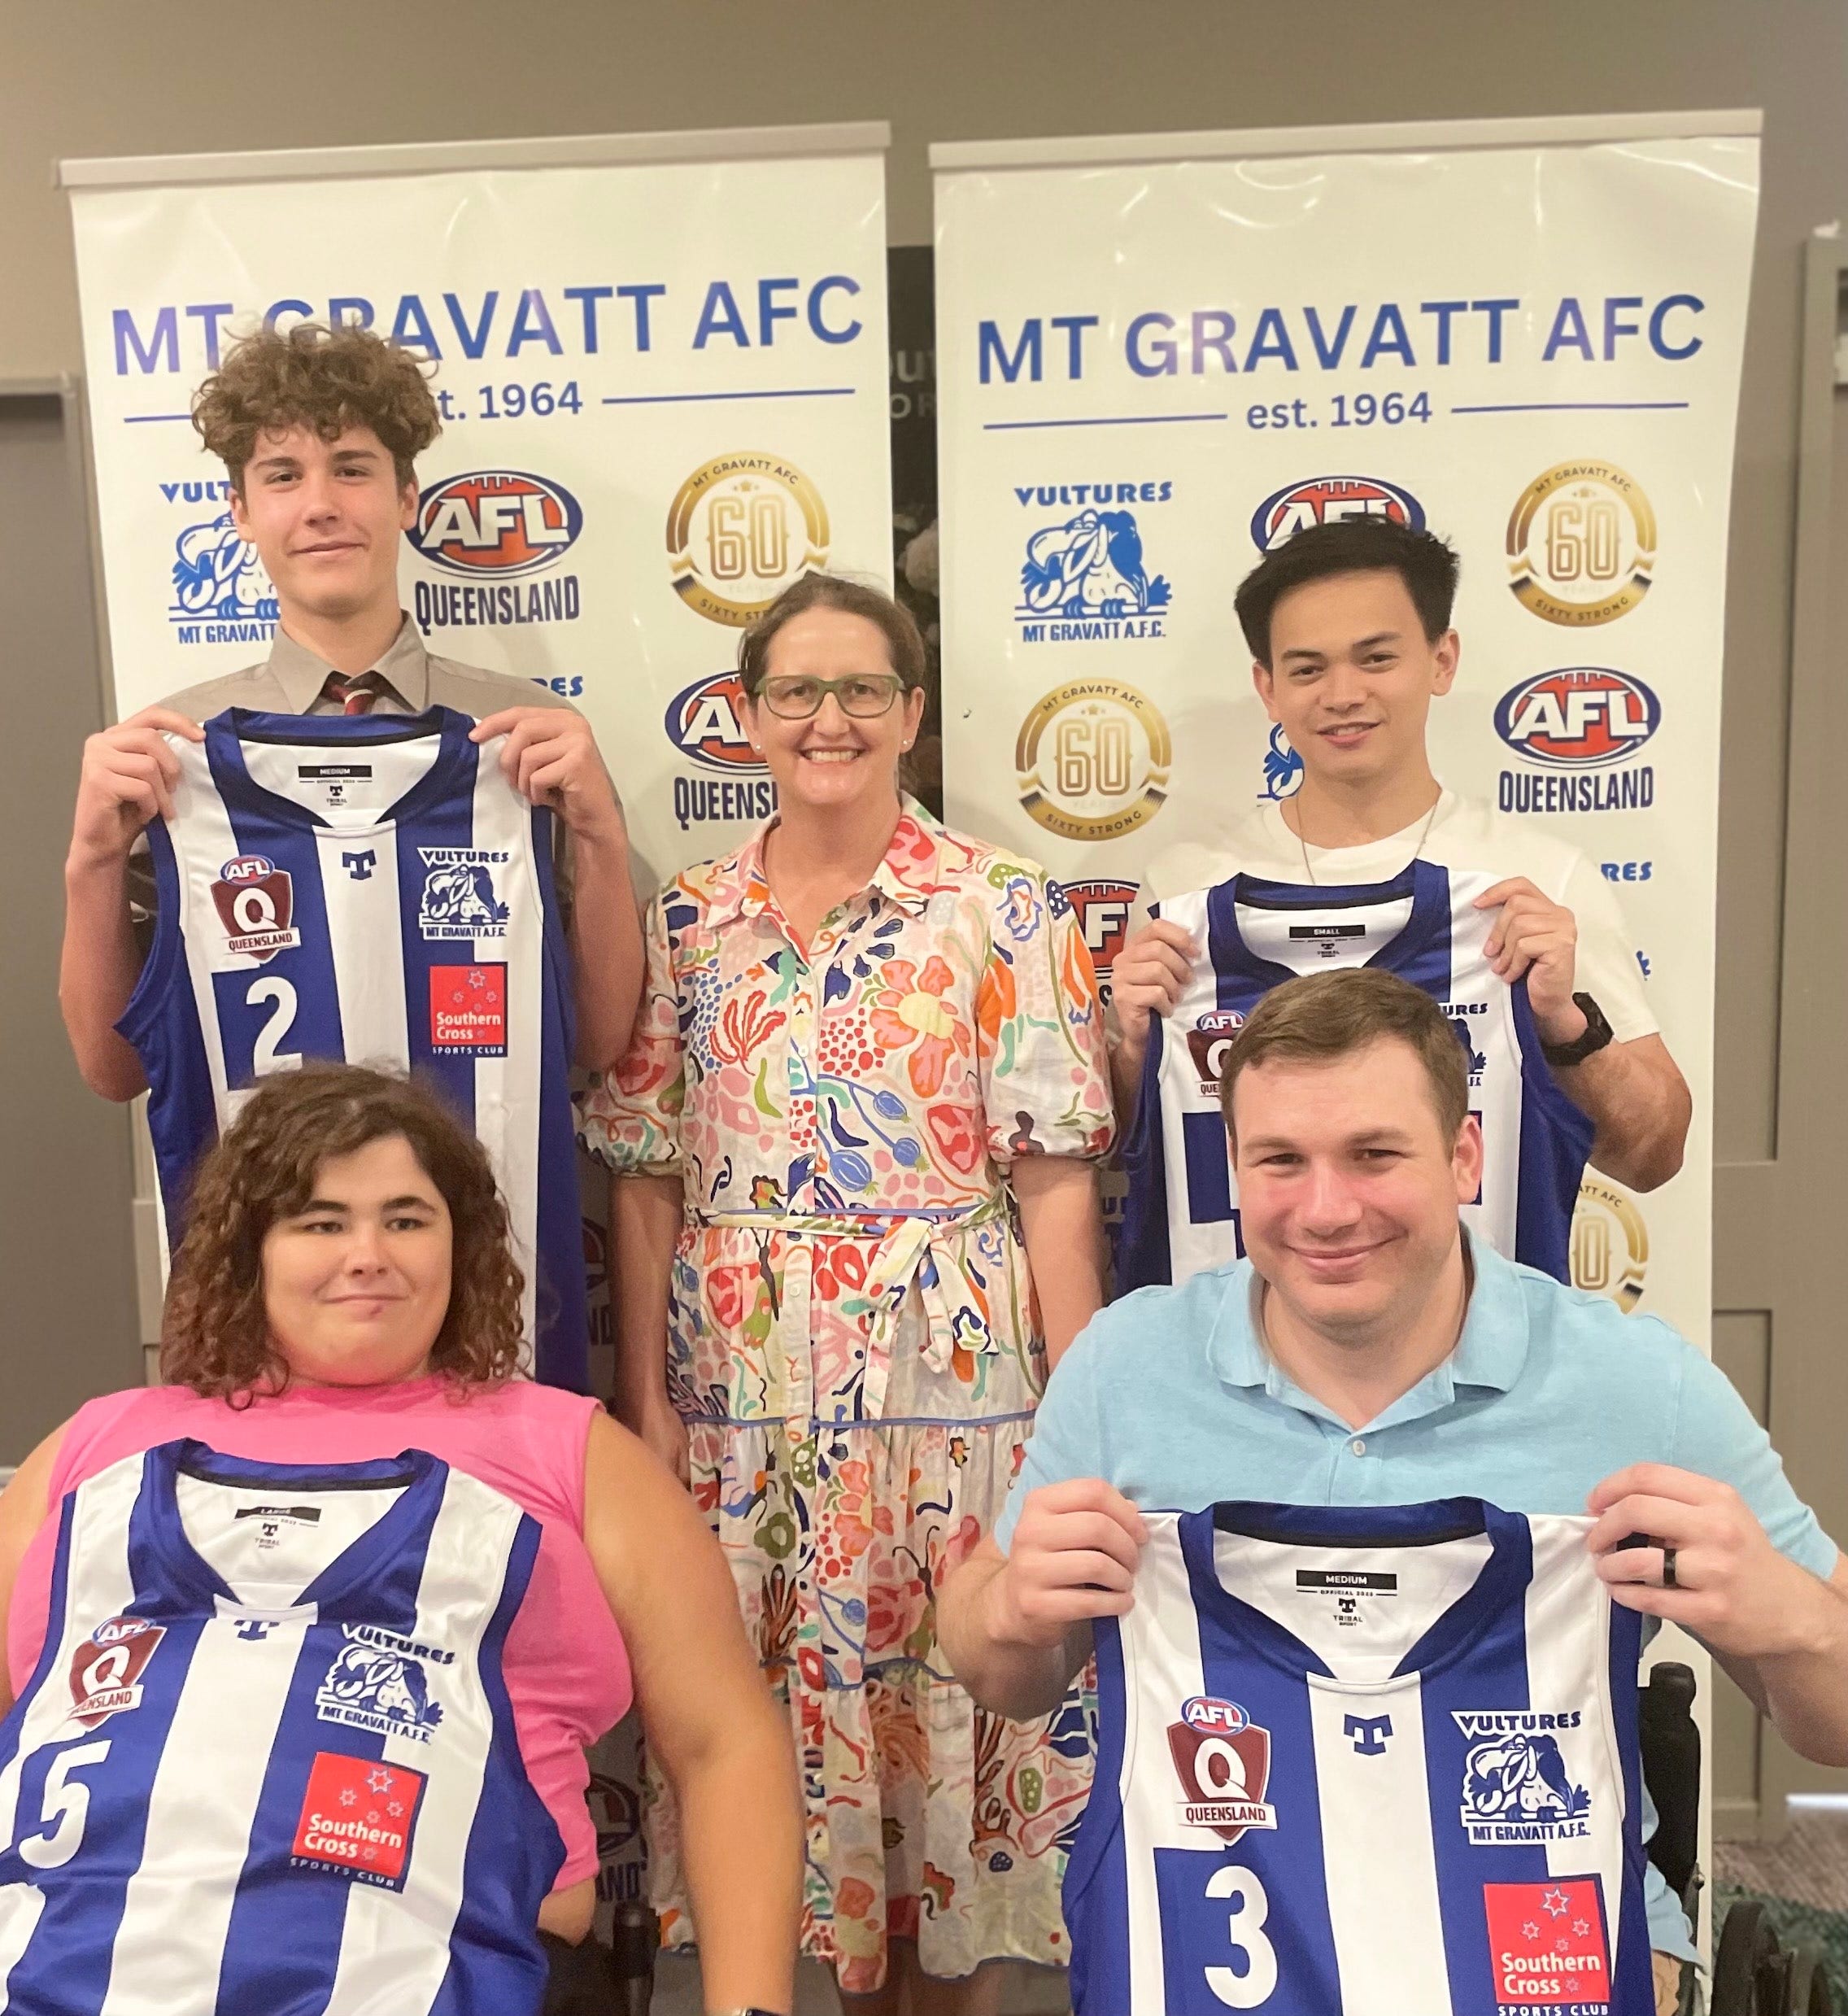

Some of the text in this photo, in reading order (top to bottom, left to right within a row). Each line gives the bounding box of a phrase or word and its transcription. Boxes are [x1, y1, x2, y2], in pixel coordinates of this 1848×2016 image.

[111, 303, 233, 376] MT
[691, 275, 863, 350] AFC
[978, 315, 1099, 384] MT
[1125, 299, 1519, 378] GRAVATT
[1541, 294, 1706, 362] AFC
[478, 381, 583, 419] 1964
[1245, 391, 1432, 429] est. 1964
[693, 459, 798, 489] MT GRAVATT AFC
[1535, 467, 1632, 494] MT GRAVATT AFC
[159, 481, 231, 504] VULT
[1014, 482, 1172, 507] VULTURES
[421, 494, 570, 549] AFL
[708, 493, 787, 581] 60
[1548, 500, 1619, 582] 60
[415, 575, 580, 635] QUEENSLAND
[700, 598, 739, 621] SIXTY
[1536, 596, 1629, 621] SIXTY STRONG
[178, 626, 201, 644] MT
[1022, 621, 1166, 643] MT GRAVATT A.F.C.
[1043, 684, 1144, 712] MT GRAVATT AFC
[1508, 690, 1649, 740] AFL
[1057, 718, 1131, 797] 60
[1499, 766, 1654, 814] QUEENSLAND
[1045, 810, 1142, 835] SIXTY STRONG
[422, 850, 509, 863] VULTURES
[226, 861, 270, 880] AFL
[233, 888, 280, 932] Q
[229, 932, 293, 952] QUEENSLAND
[436, 1011, 501, 1025] Southern
[1442, 1002, 1488, 1016] URES
[246, 976, 303, 1077] 2
[436, 1026, 473, 1039] Cross
[1201, 1015, 1244, 1031] AFL
[433, 1046, 503, 1054] SPORTS CLUB
[1601, 1191, 1622, 1207] AFC
[1325, 1575, 1367, 1585] MEDIUM
[343, 1623, 455, 1665] VULTURES
[1188, 1704, 1243, 1728] AFL
[1458, 1711, 1581, 1731] VULTURES
[1194, 1738, 1251, 1800] Q
[19, 1739, 112, 1869] 5
[1186, 1806, 1266, 1824] QUEENSLAND
[307, 1813, 402, 1848] Southern
[1473, 1826, 1492, 1840] MT
[1496, 1825, 1554, 1840] GRAVATT
[304, 1832, 359, 1858] Cross
[290, 1857, 395, 1887] SPORTS CLUB
[1205, 1865, 1278, 2009] 3
[1501, 1953, 1601, 1972] Southern
[1504, 1975, 1561, 1995] Cross
[1497, 2005, 1608, 2016] SPORTS CLUB
